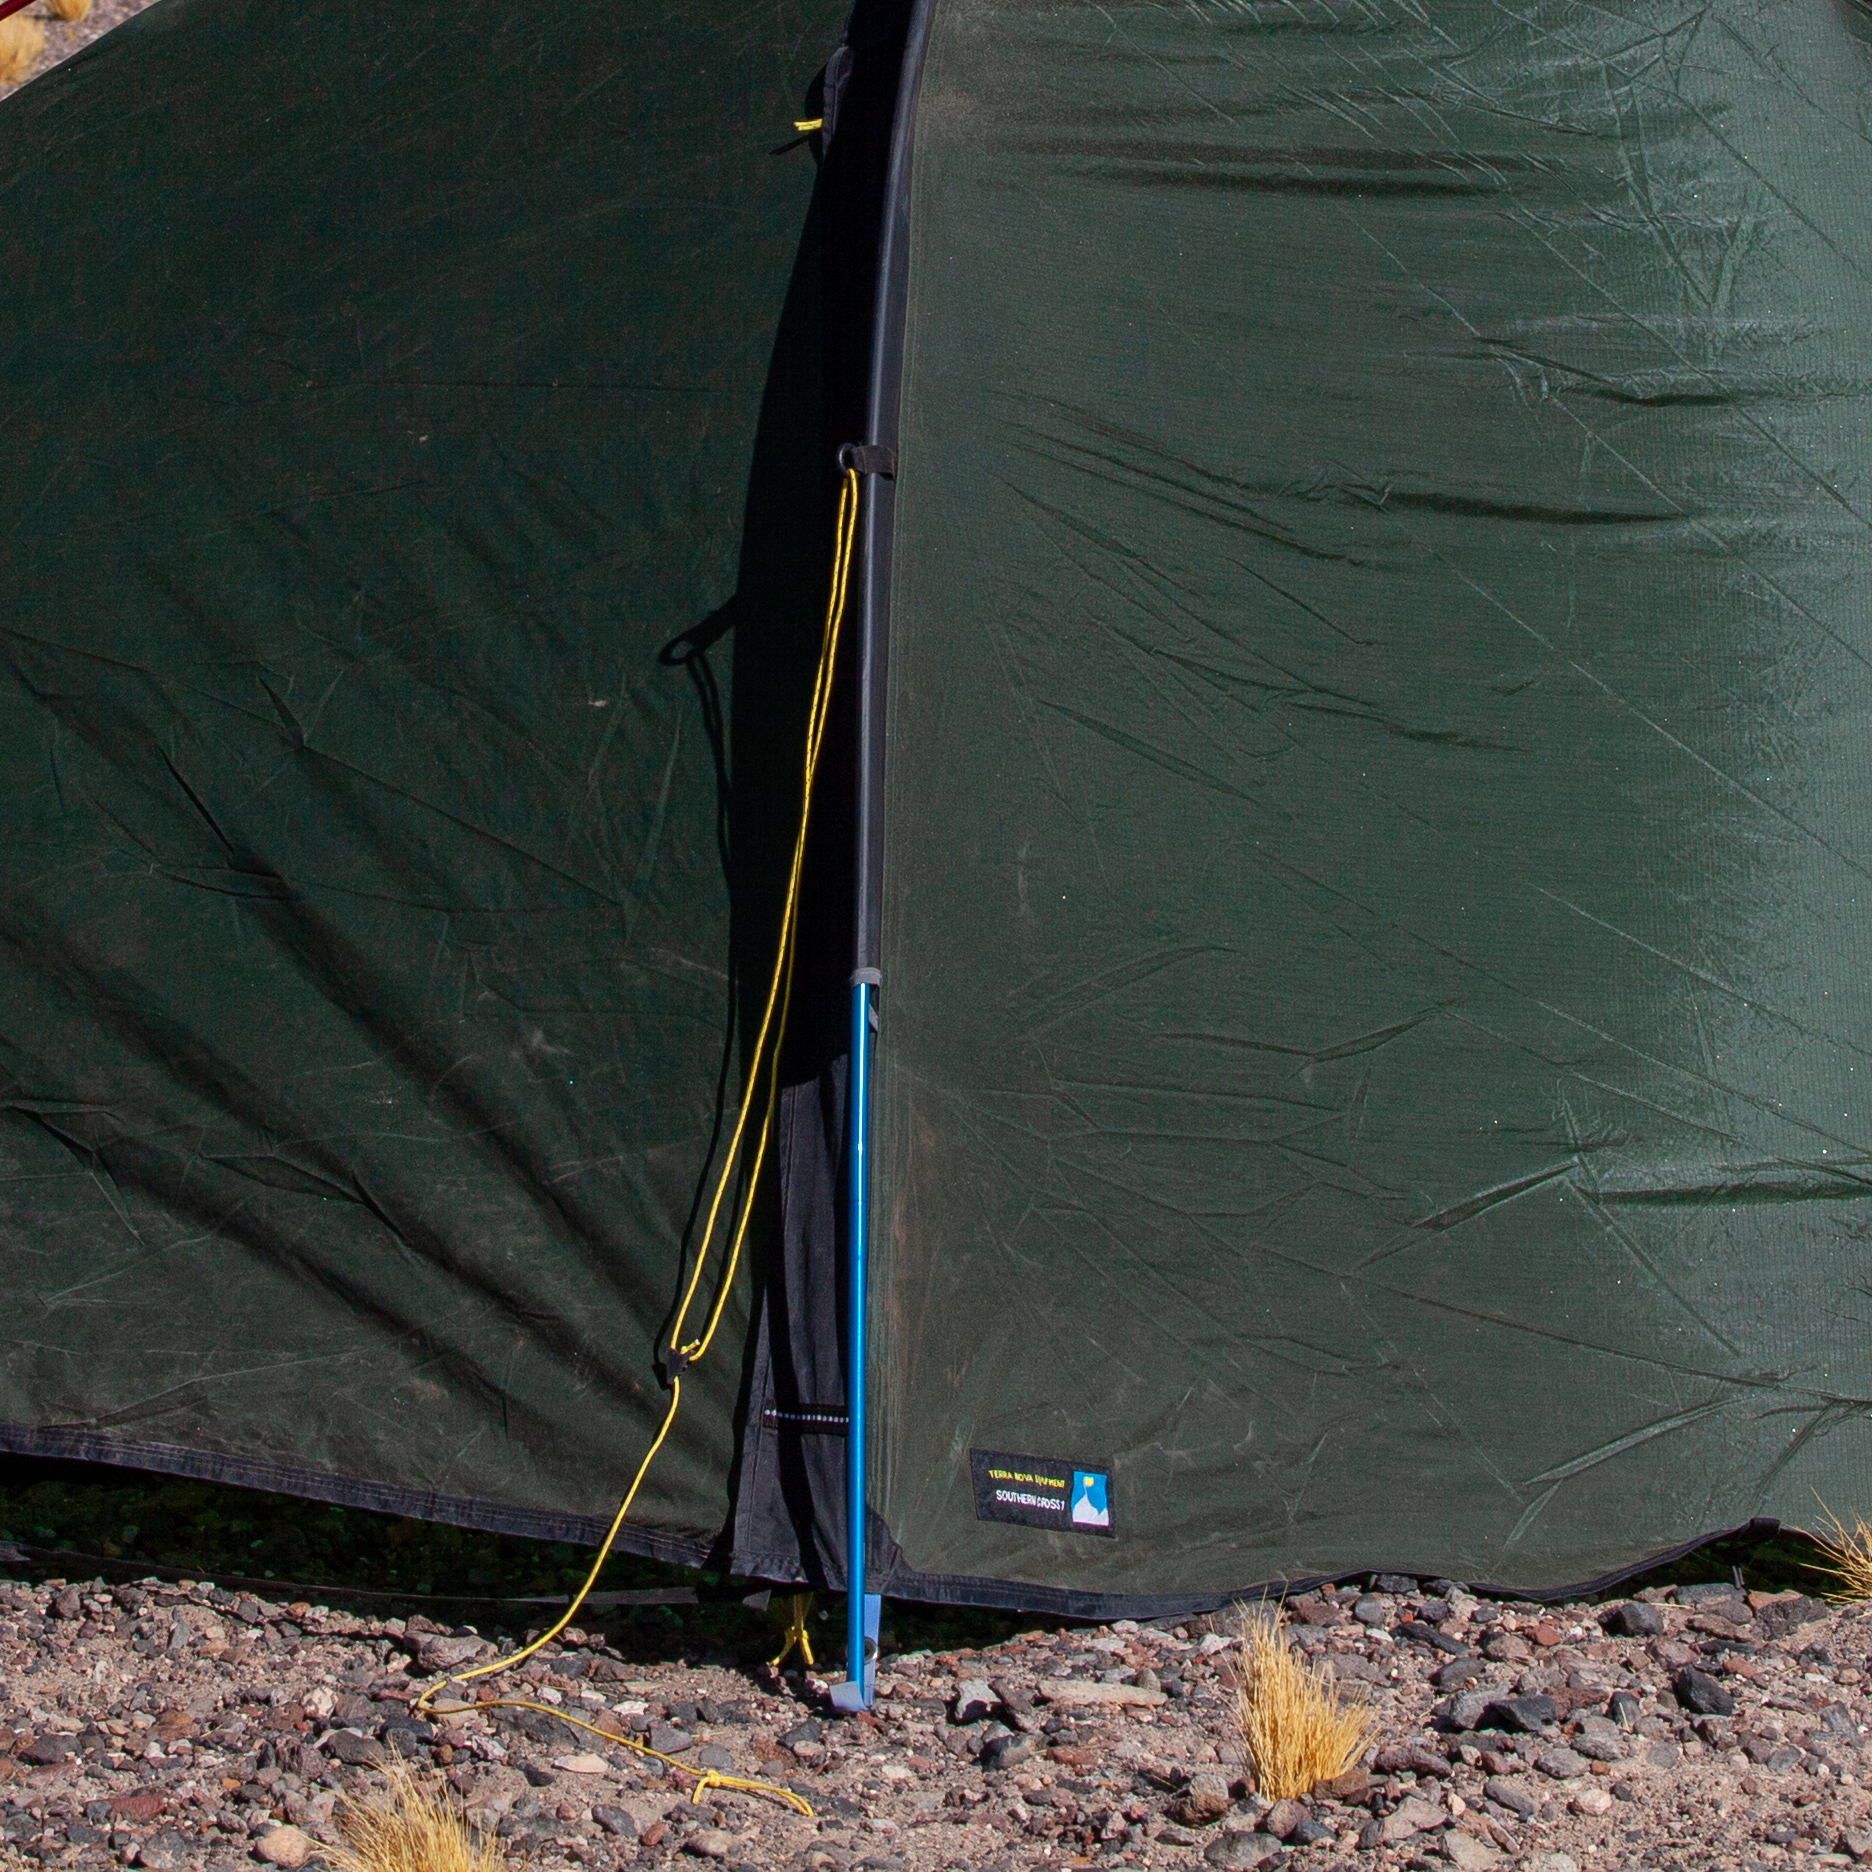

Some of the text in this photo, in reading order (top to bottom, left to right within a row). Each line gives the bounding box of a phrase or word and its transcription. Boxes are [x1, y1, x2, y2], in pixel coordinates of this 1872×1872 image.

[988, 1469, 1013, 1480] TERRA
[1014, 1472, 1034, 1483] NOVA
[995, 1489, 1036, 1506] SOUTHERN
[1060, 1500, 1066, 1511] 1
